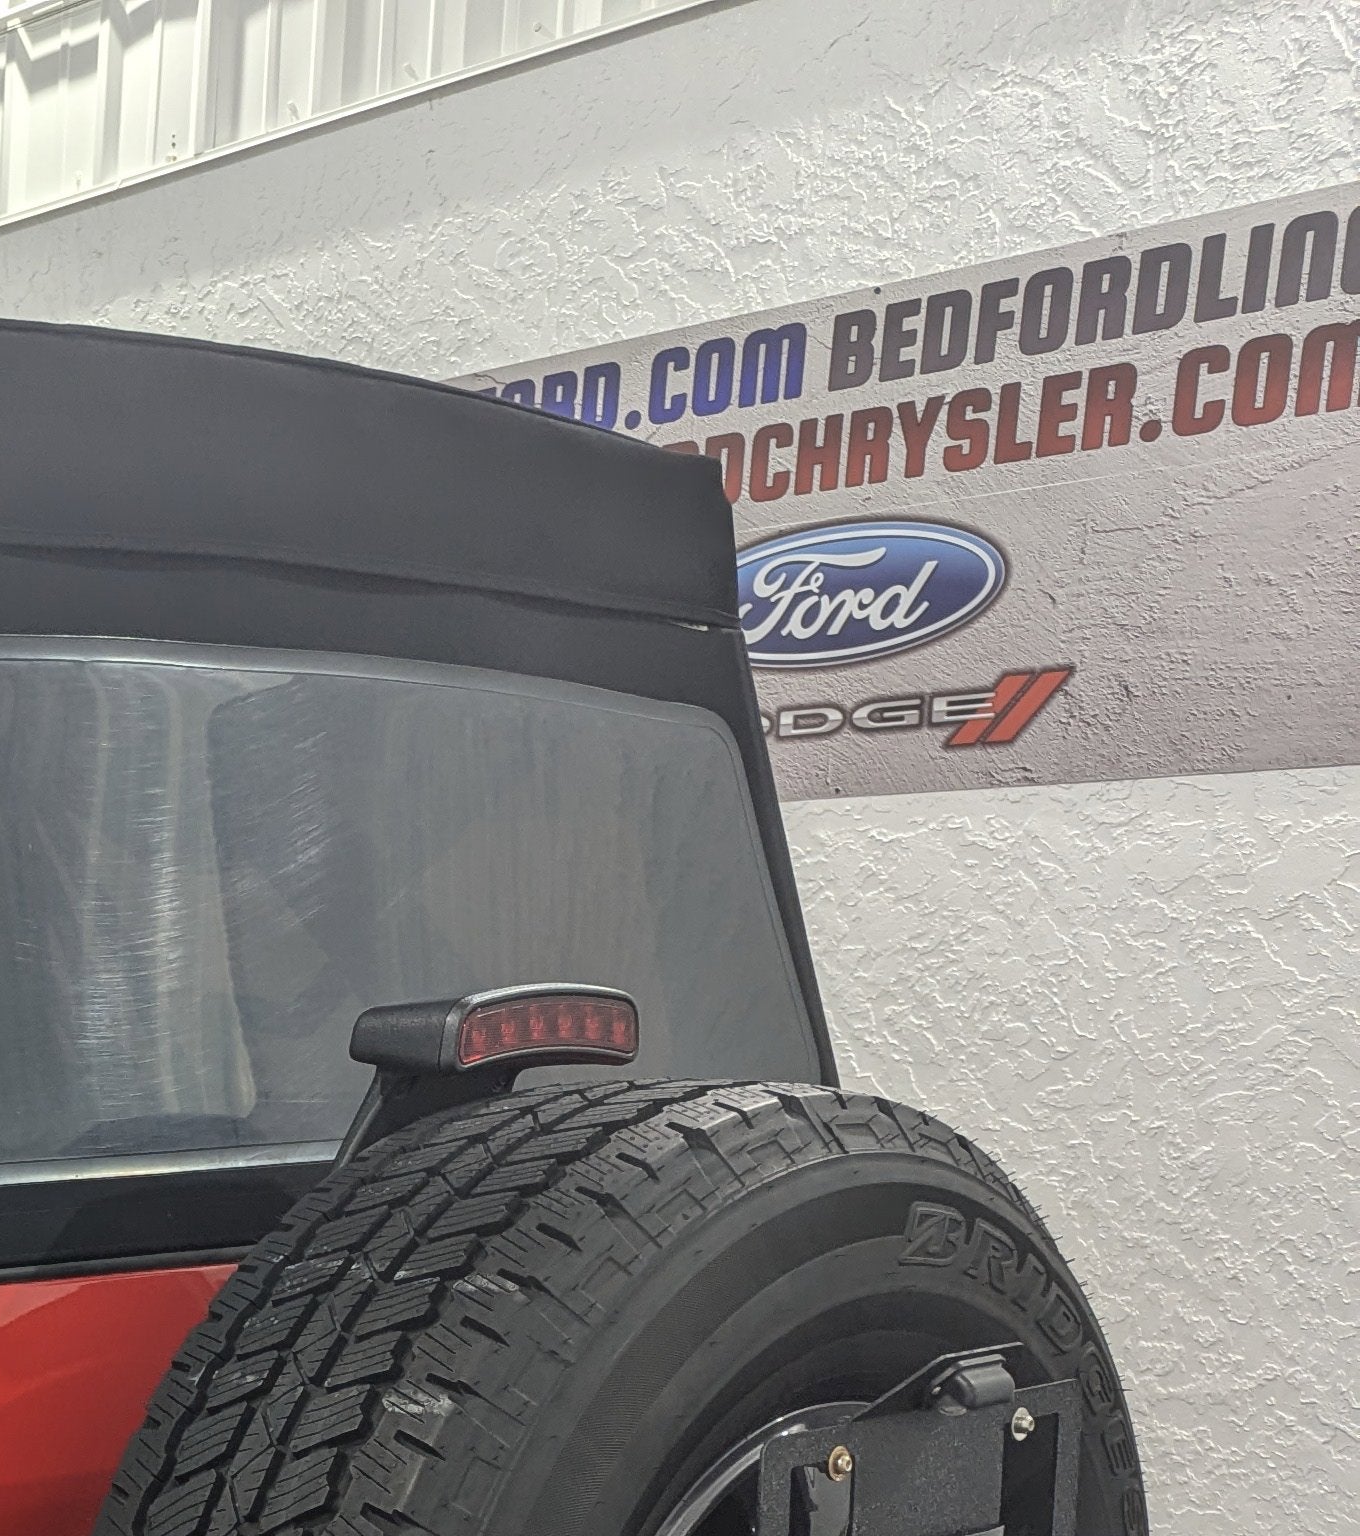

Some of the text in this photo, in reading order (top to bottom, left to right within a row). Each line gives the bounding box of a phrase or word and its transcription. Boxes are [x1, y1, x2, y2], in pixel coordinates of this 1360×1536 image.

[478, 323, 806, 432] RD.COM
[662, 319, 1360, 504] DCHRYSLER.COM
[739, 547, 938, 645] Ford
[762, 692, 996, 737] DGE
